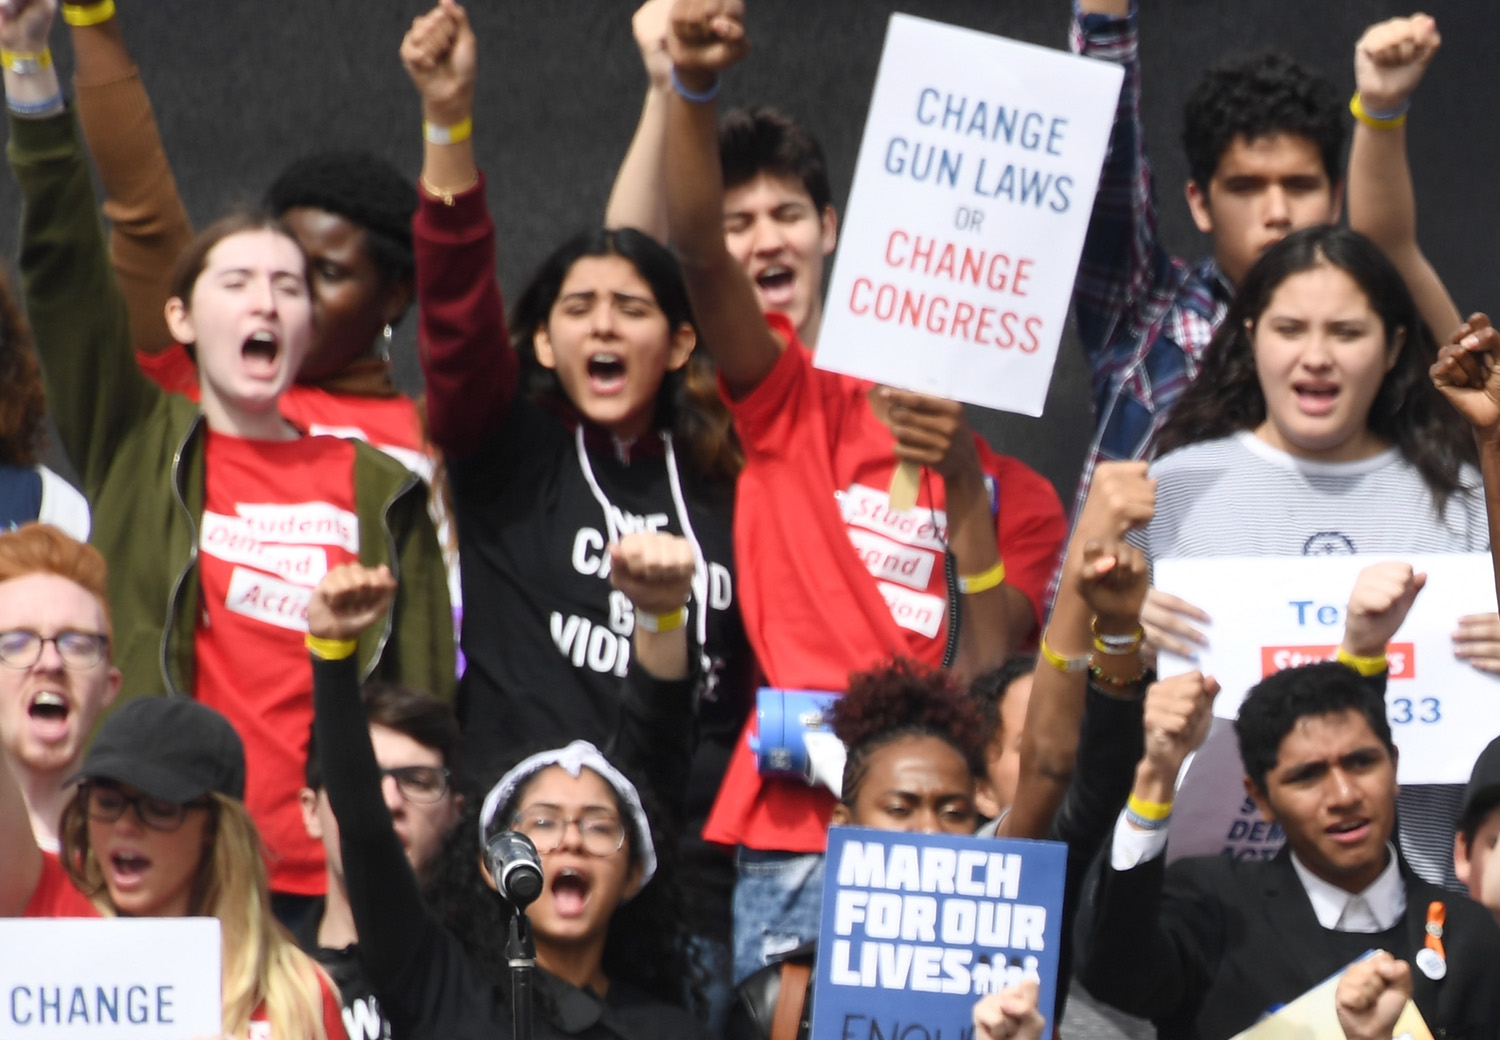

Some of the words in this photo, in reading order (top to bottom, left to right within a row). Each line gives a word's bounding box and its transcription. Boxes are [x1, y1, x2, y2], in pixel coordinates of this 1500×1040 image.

[916, 88, 1069, 156] CHANGE
[884, 136, 963, 188] GUN
[974, 157, 1074, 213] LAWS
[954, 206, 985, 232] OR
[885, 230, 1034, 297] CHANGE
[849, 277, 1043, 355] CONGRESS
[1289, 601, 1344, 627] Te
[838, 840, 1022, 900] MARCH
[834, 890, 937, 942] FOR
[941, 898, 1047, 951] OUR
[830, 939, 973, 995] LIVES
[10, 985, 175, 1025] CHANGE
